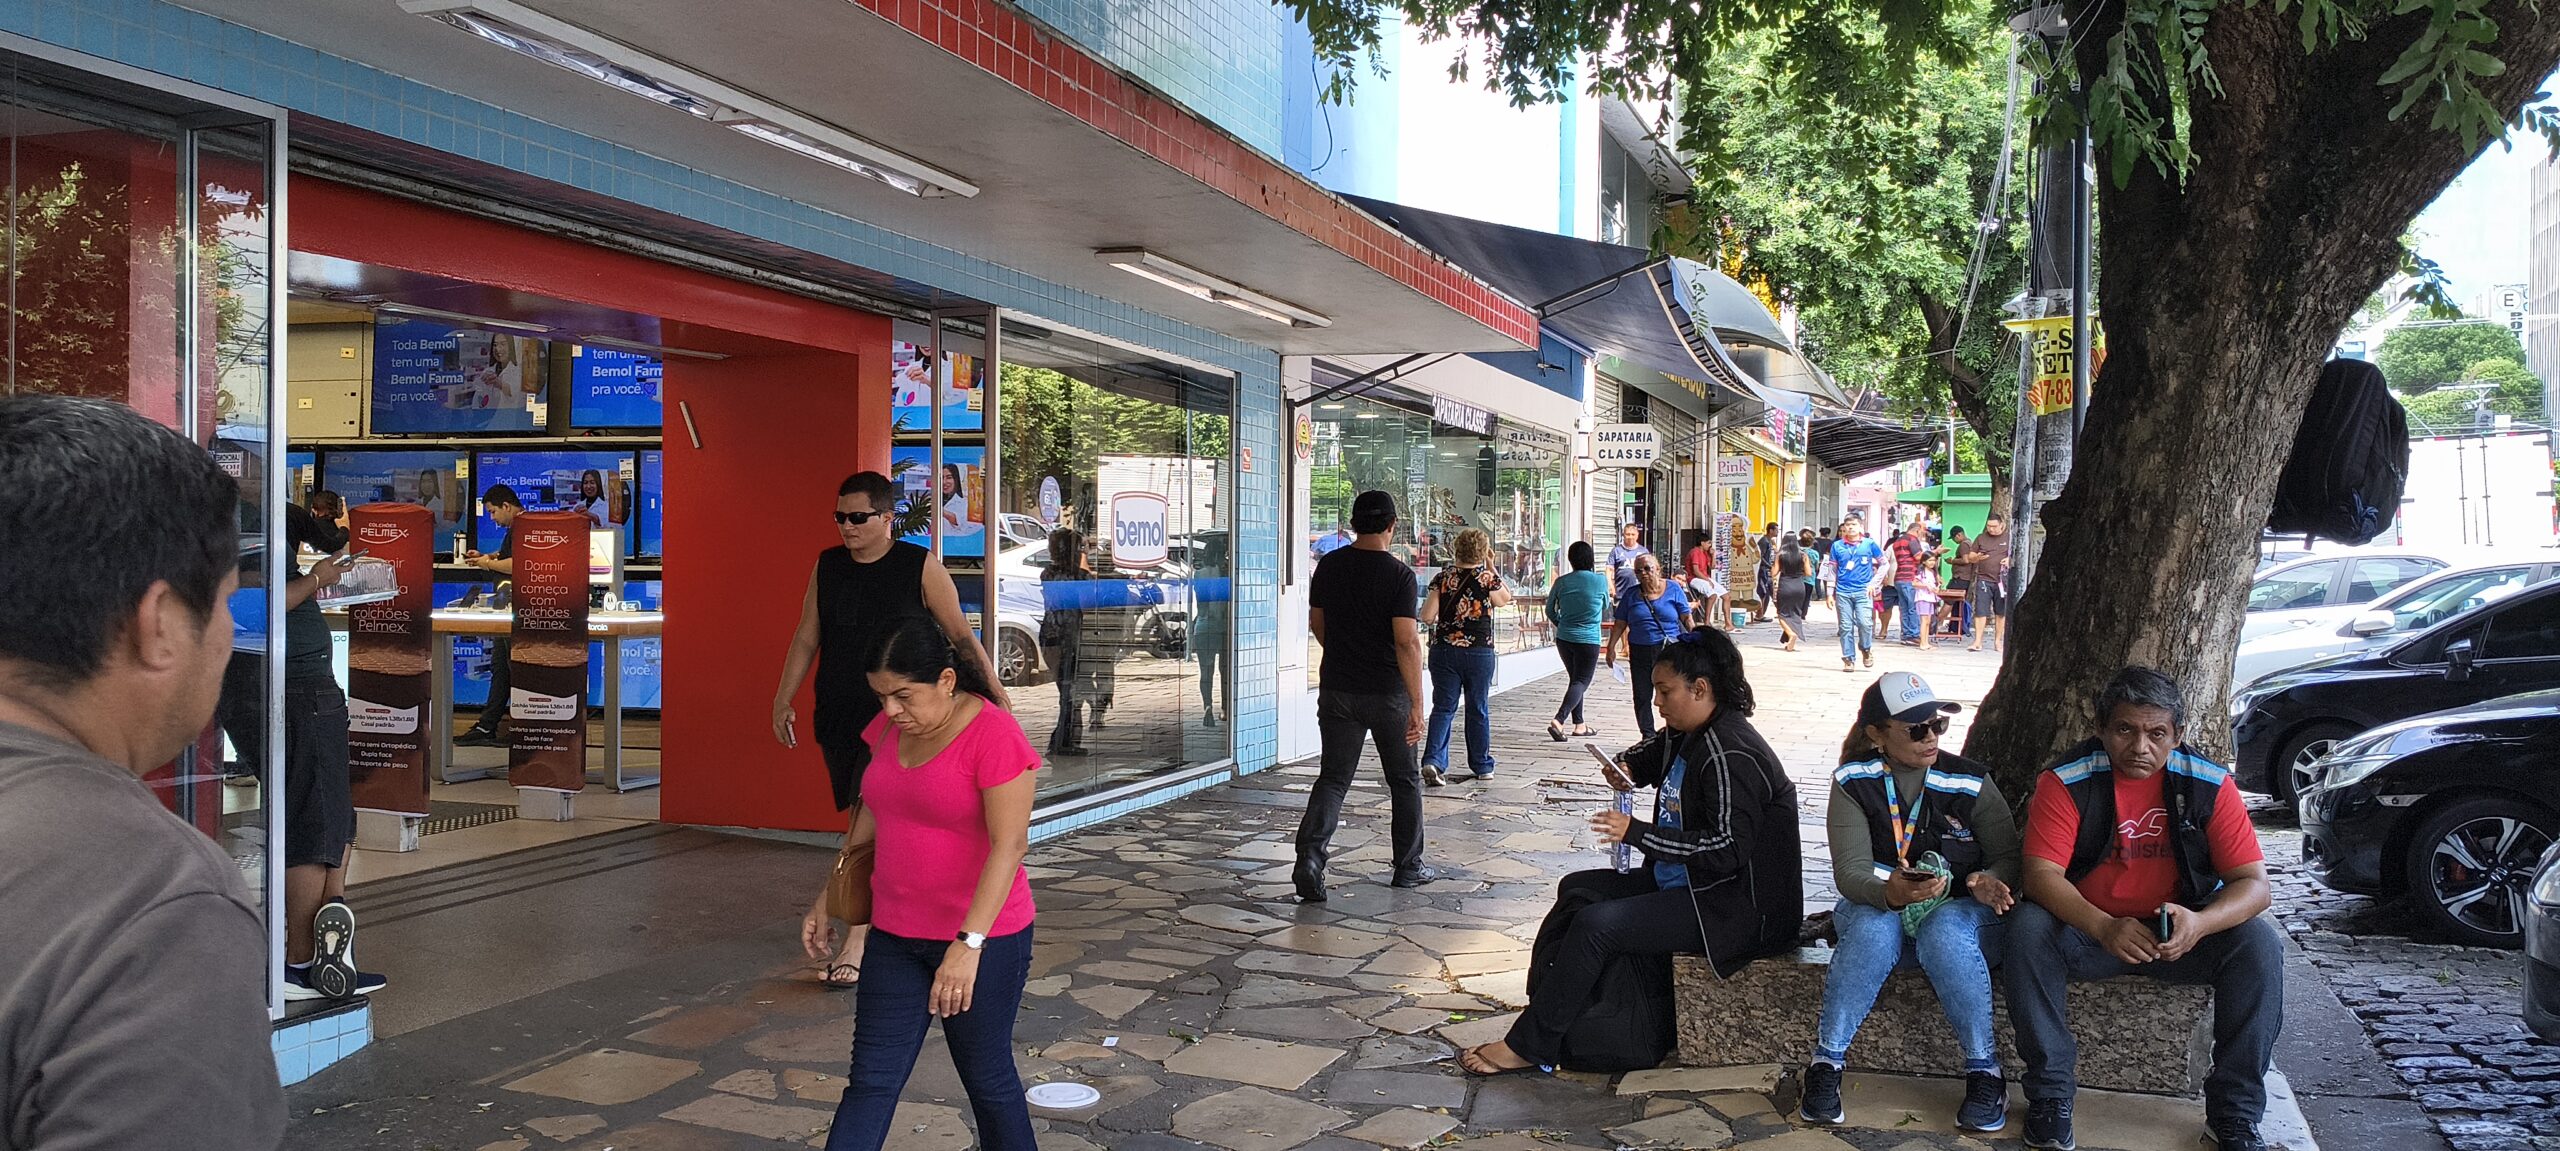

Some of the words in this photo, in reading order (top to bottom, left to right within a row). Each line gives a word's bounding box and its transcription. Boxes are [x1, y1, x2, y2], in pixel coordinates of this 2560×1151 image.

[392, 340, 417, 350] Toda
[420, 338, 456, 349] Bemol
[592, 349, 617, 359] tem
[392, 358, 412, 367] tem
[415, 358, 440, 367] uma
[592, 366, 632, 377] Bemol
[635, 366, 663, 377] Farm
[391, 373, 426, 385] Bemol
[428, 373, 464, 384] Farma
[591, 386, 611, 397] pra
[613, 383, 644, 395] você.
[391, 393, 407, 404] pra
[410, 390, 437, 401] você.
[1432, 394, 1465, 430] SAPATARIA
[1465, 405, 1487, 434] CLASSE
[1598, 432, 1653, 442] SAPATARIA
[1598, 449, 1651, 459] CLASSE
[1718, 459, 1747, 472] Pink
[495, 477, 518, 485] Toda
[520, 476, 551, 486] Bemol
[360, 528, 408, 538] PELMEX
[1116, 511, 1164, 547] bemol
[524, 535, 568, 544] PELMEX
[524, 560, 565, 571] Dormir
[530, 572, 557, 583] bem
[520, 585, 568, 596] começa
[530, 597, 556, 606] com
[354, 607, 410, 619] colchões
[519, 606, 570, 618] colchões
[359, 620, 407, 633] Pelmex.
[523, 618, 567, 629] Pelmex.
[453, 646, 482, 656] arma
